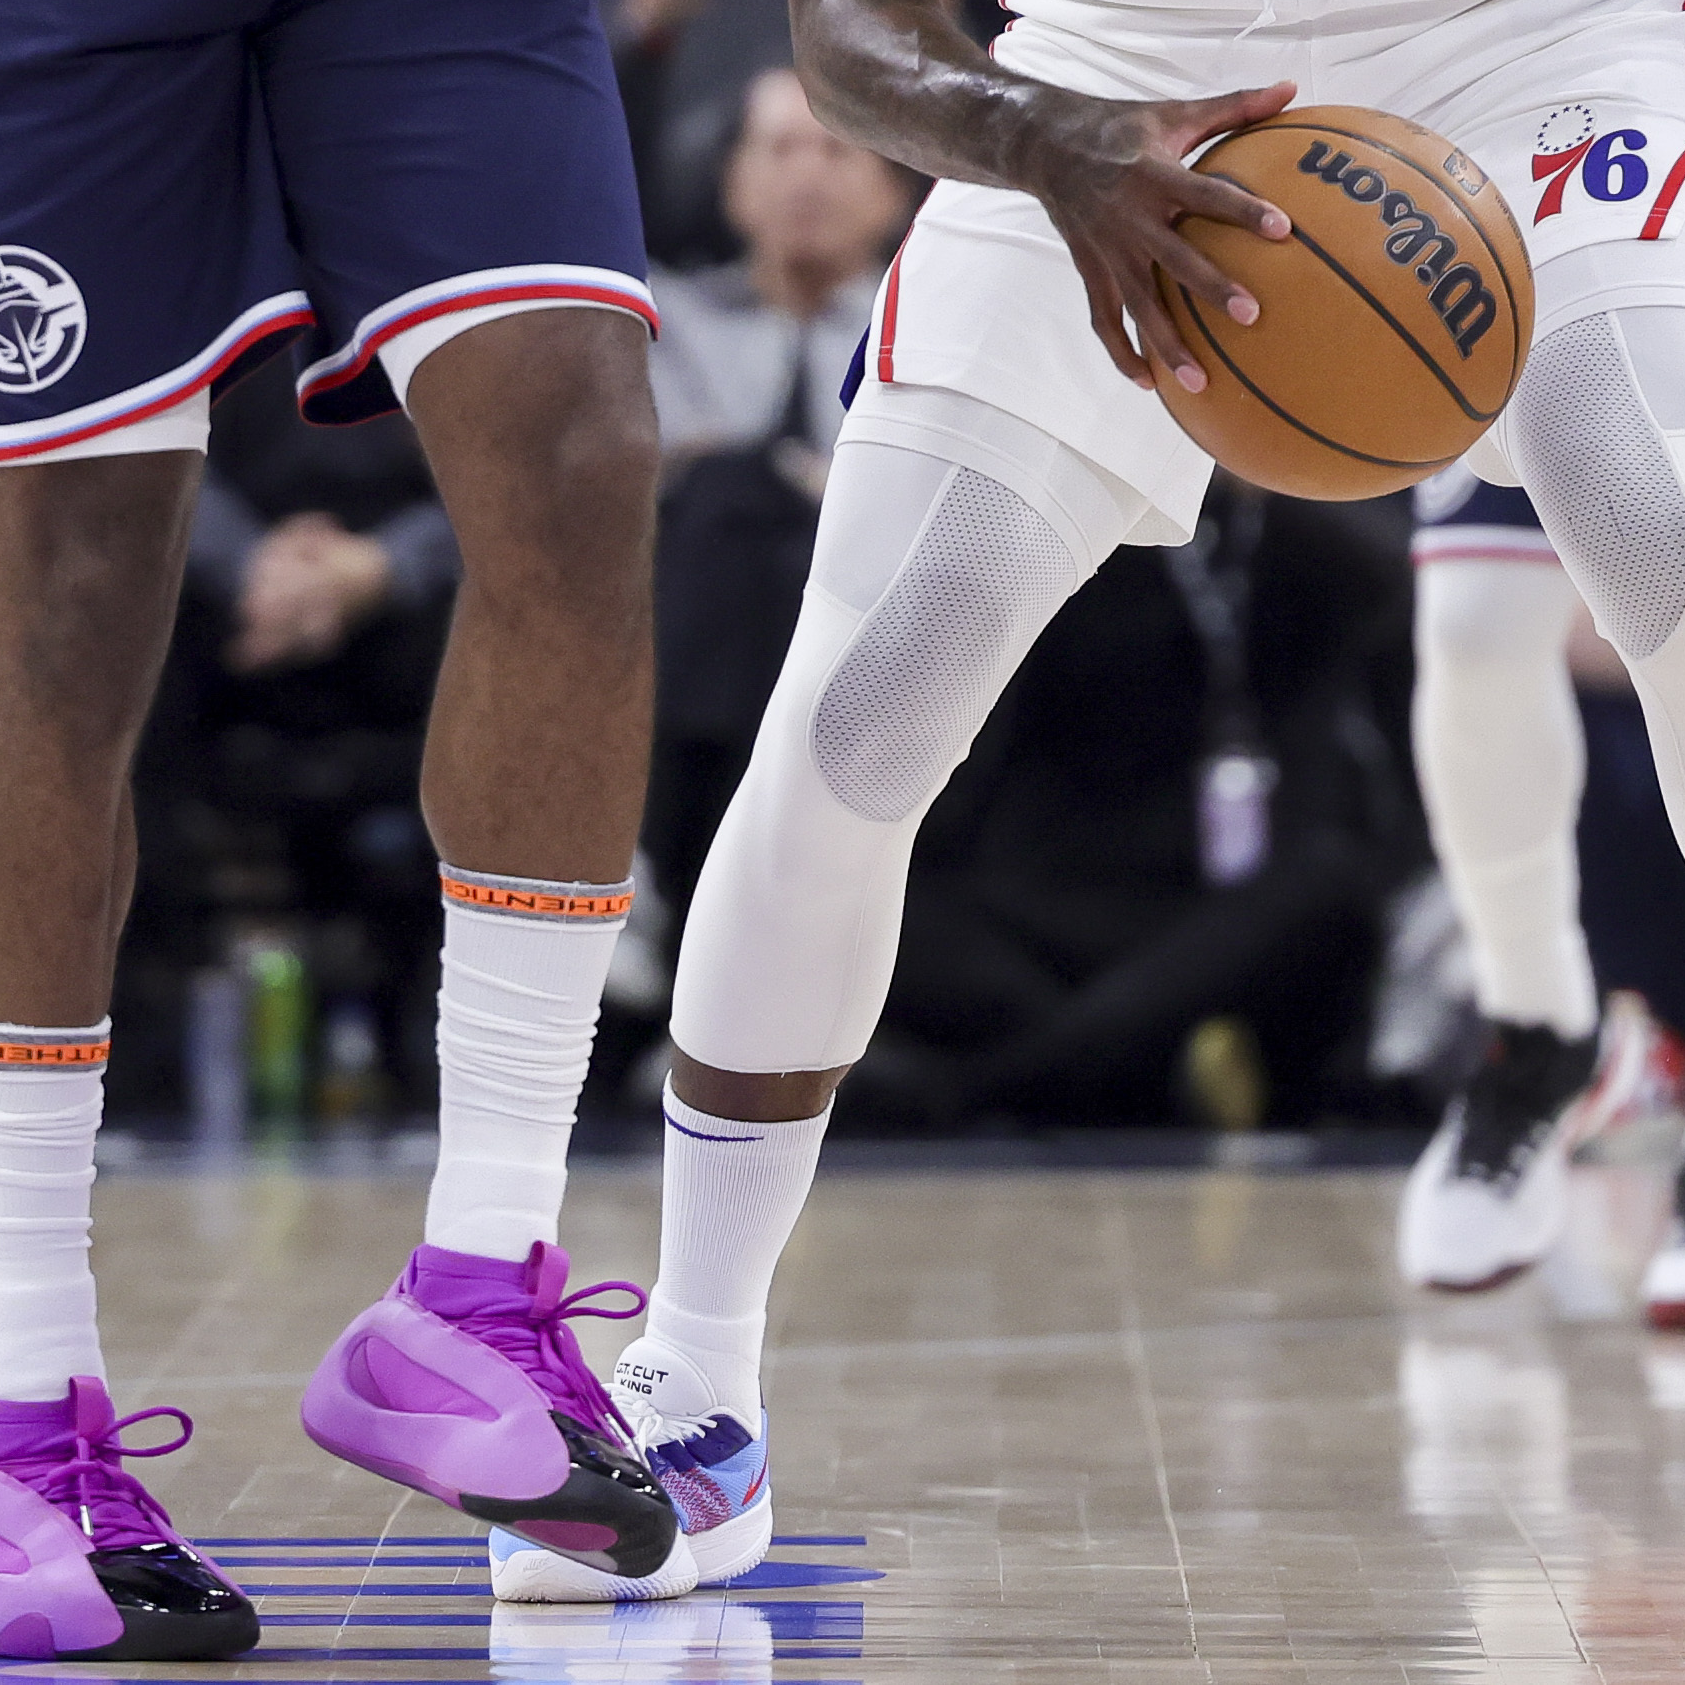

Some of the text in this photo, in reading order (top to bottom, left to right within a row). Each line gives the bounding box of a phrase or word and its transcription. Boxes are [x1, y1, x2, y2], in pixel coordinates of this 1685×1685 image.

[1531, 128, 1649, 227] 76
[1296, 139, 1497, 362] Wilson
[620, 1378, 653, 1395] KING
[632, 1365, 669, 1383] CUT
